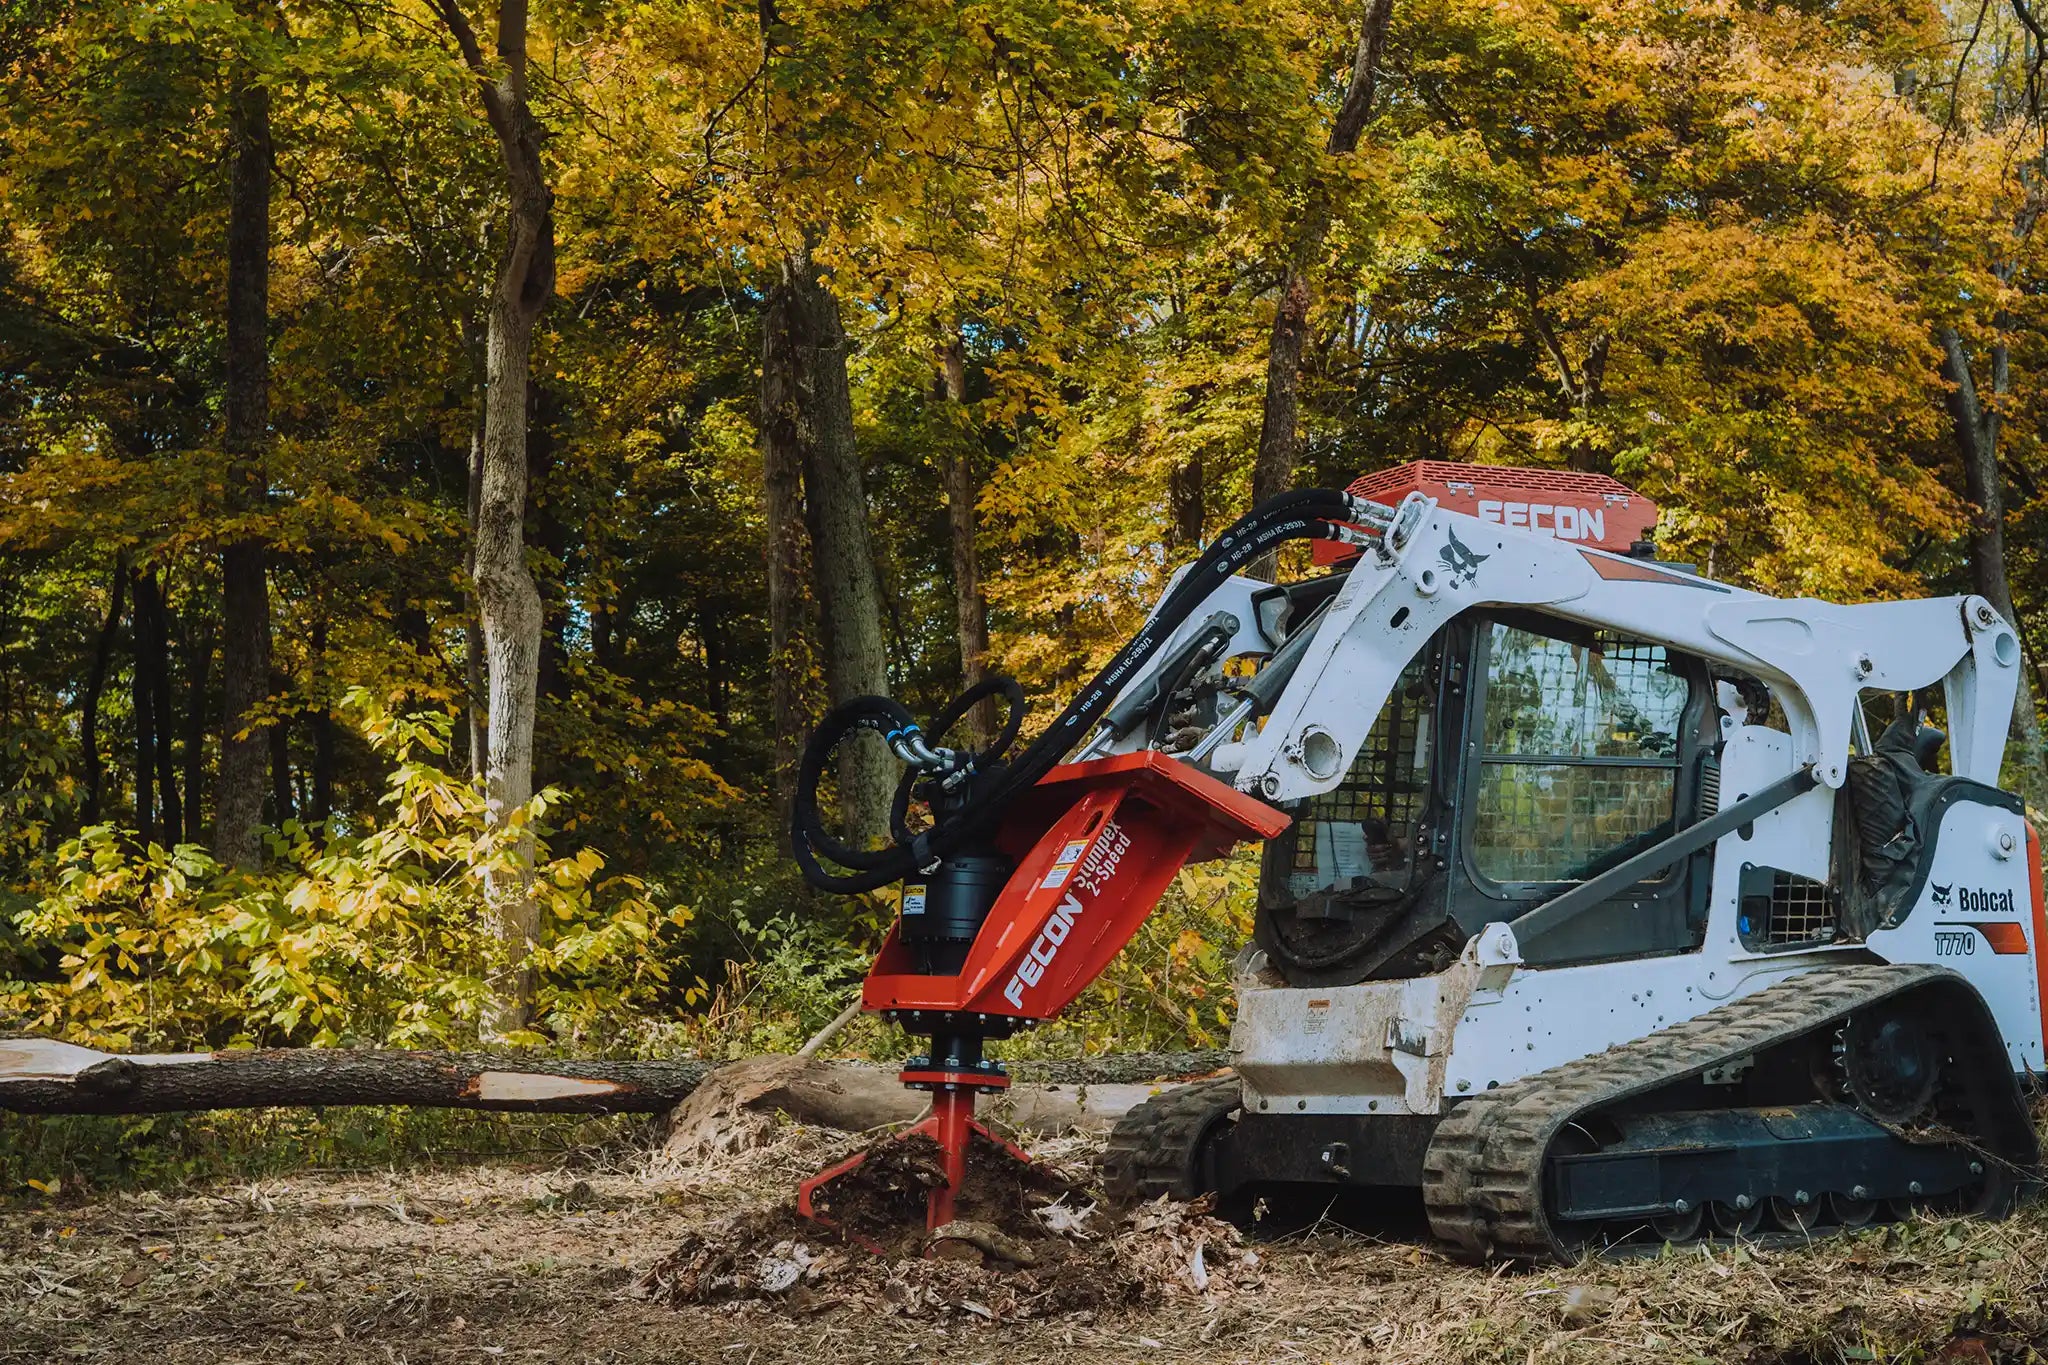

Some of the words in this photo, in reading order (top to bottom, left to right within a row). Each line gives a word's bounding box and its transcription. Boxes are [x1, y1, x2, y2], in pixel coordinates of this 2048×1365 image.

[1478, 500, 1605, 541] FECON
[1086, 833, 1131, 897] 2-Speed
[1959, 887, 2014, 911] Bobcat
[1004, 892, 1083, 1010] FECON
[1935, 932, 1975, 956] T770
